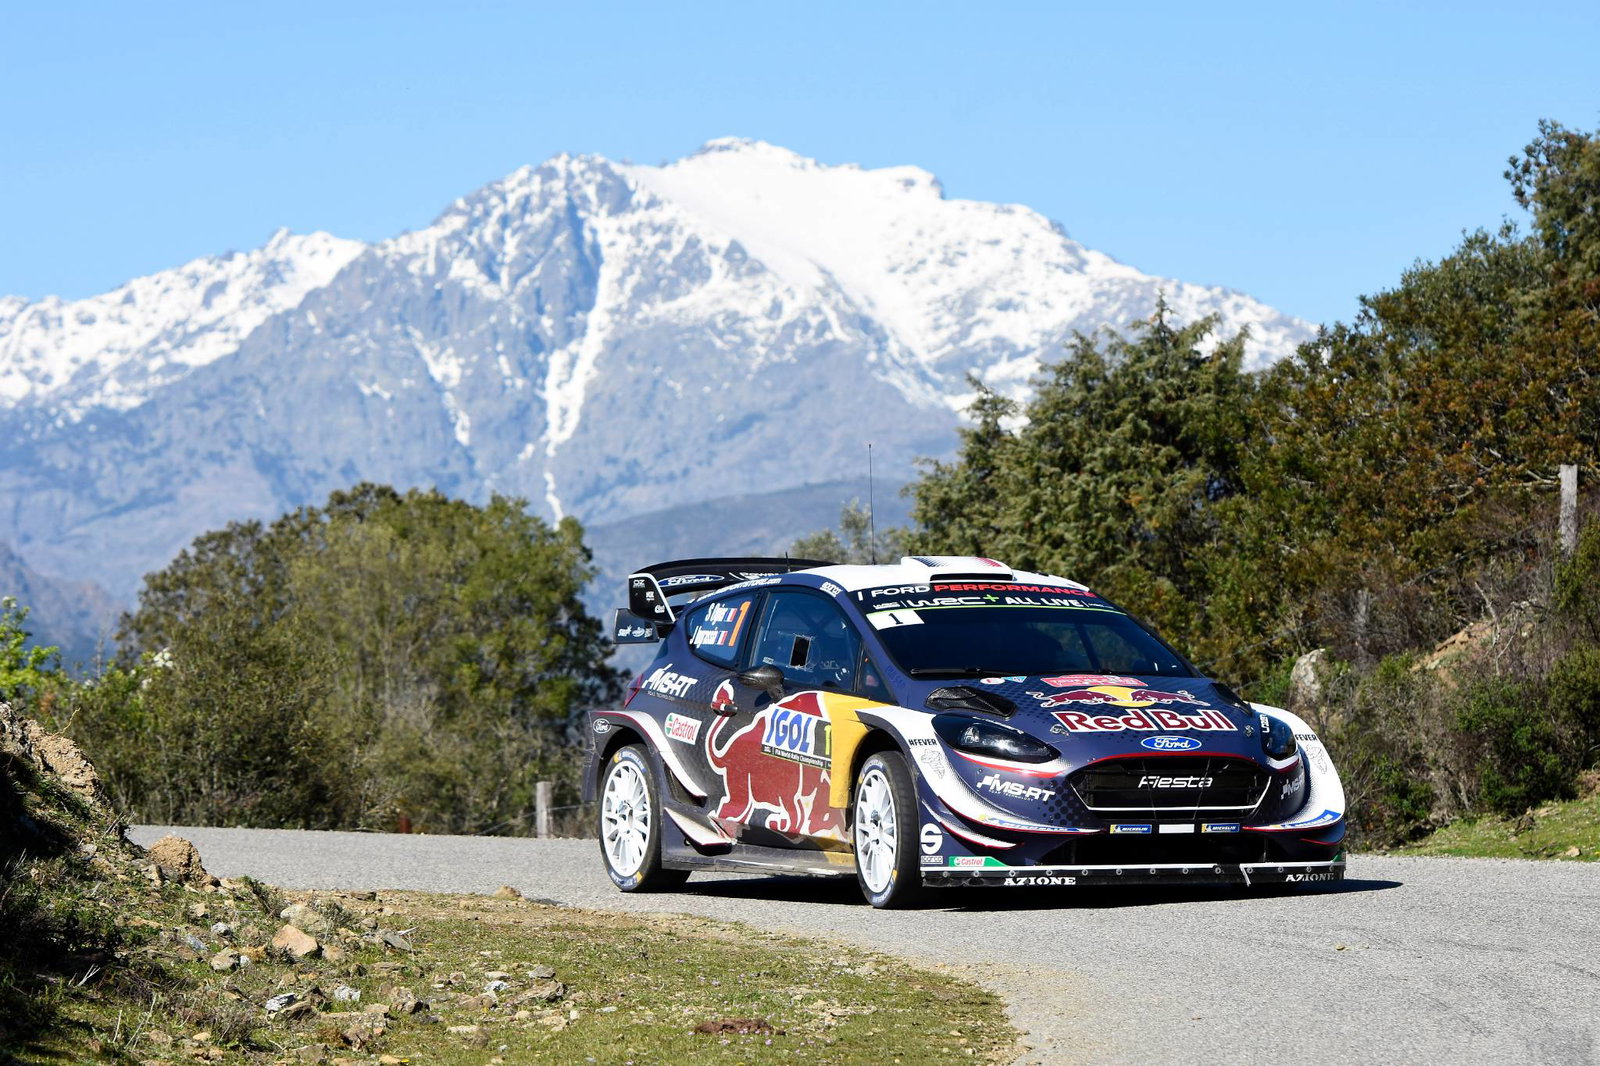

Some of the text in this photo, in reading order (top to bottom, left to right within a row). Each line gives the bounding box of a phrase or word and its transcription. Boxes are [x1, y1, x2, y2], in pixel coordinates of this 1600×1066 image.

[871, 584, 1097, 598] FORD PERFORMANCE
[1005, 597, 1041, 605] ALL
[1045, 597, 1085, 607] LIVE
[728, 601, 751, 646] 1
[888, 612, 903, 625] 1
[1055, 710, 1155, 731] Red
[1150, 709, 1236, 730] Bull
[672, 718, 698, 741] Castrol
[765, 708, 812, 753] IGOL
[1154, 737, 1191, 749] Ford
[1138, 776, 1213, 788] Fiesta
[961, 858, 983, 866] Castrol
[1003, 877, 1076, 886] AZIONE
[1285, 873, 1335, 882] AZIONE
